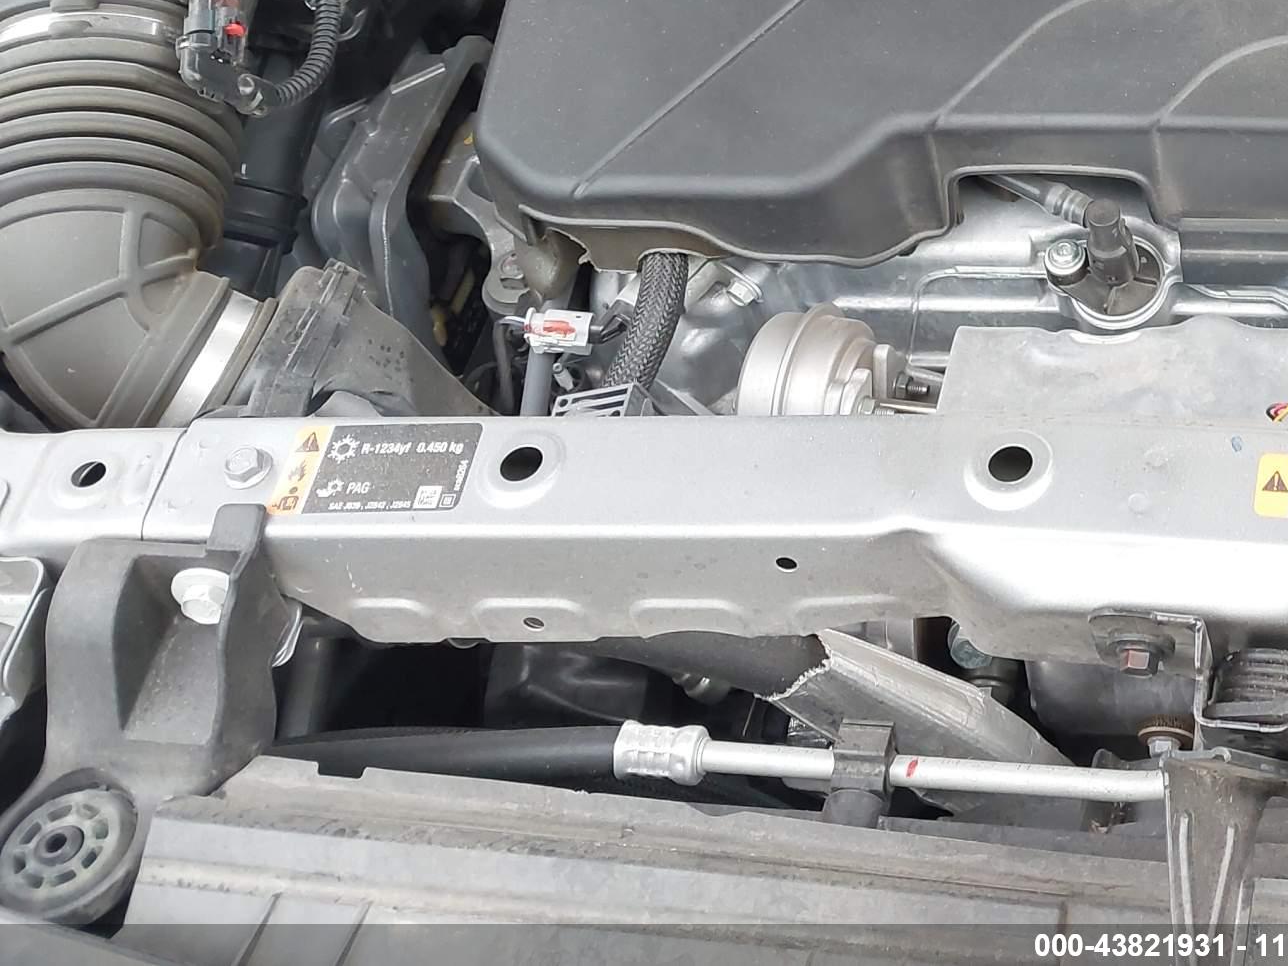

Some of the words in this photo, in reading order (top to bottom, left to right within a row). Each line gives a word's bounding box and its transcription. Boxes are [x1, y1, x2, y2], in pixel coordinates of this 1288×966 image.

[361, 442, 411, 455] R-1234yf
[415, 442, 448, 454] 0.450
[449, 441, 464, 455] kg
[346, 481, 370, 494] PAG
